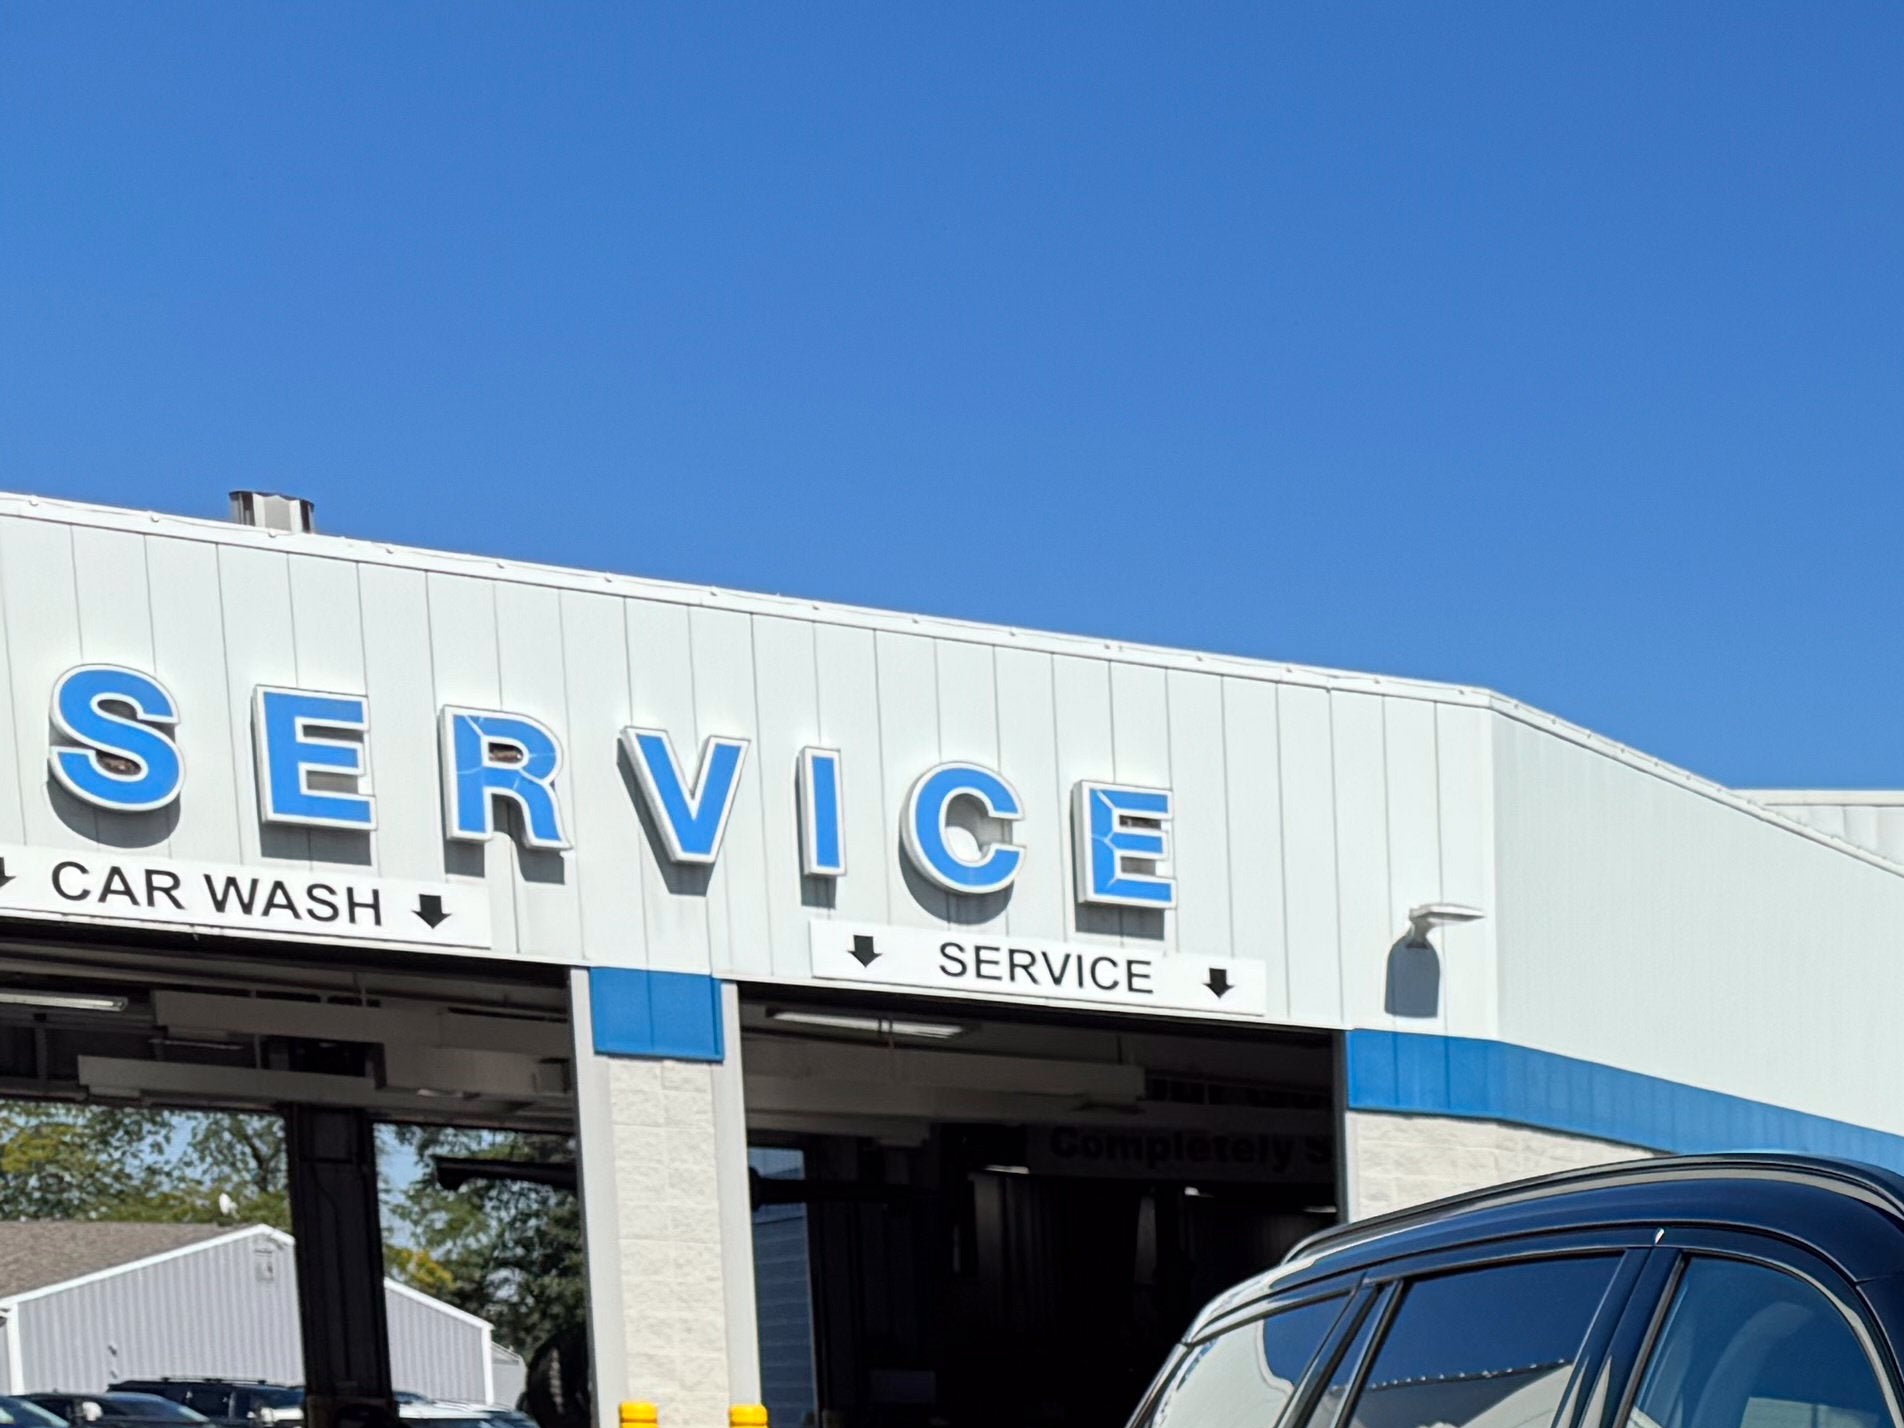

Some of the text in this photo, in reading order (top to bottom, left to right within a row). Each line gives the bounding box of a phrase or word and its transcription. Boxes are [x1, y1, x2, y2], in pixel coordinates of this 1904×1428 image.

[49, 662, 1177, 909] SERVICE
[50, 860, 383, 927] CAR WASH
[939, 941, 1154, 995] SERVICE
